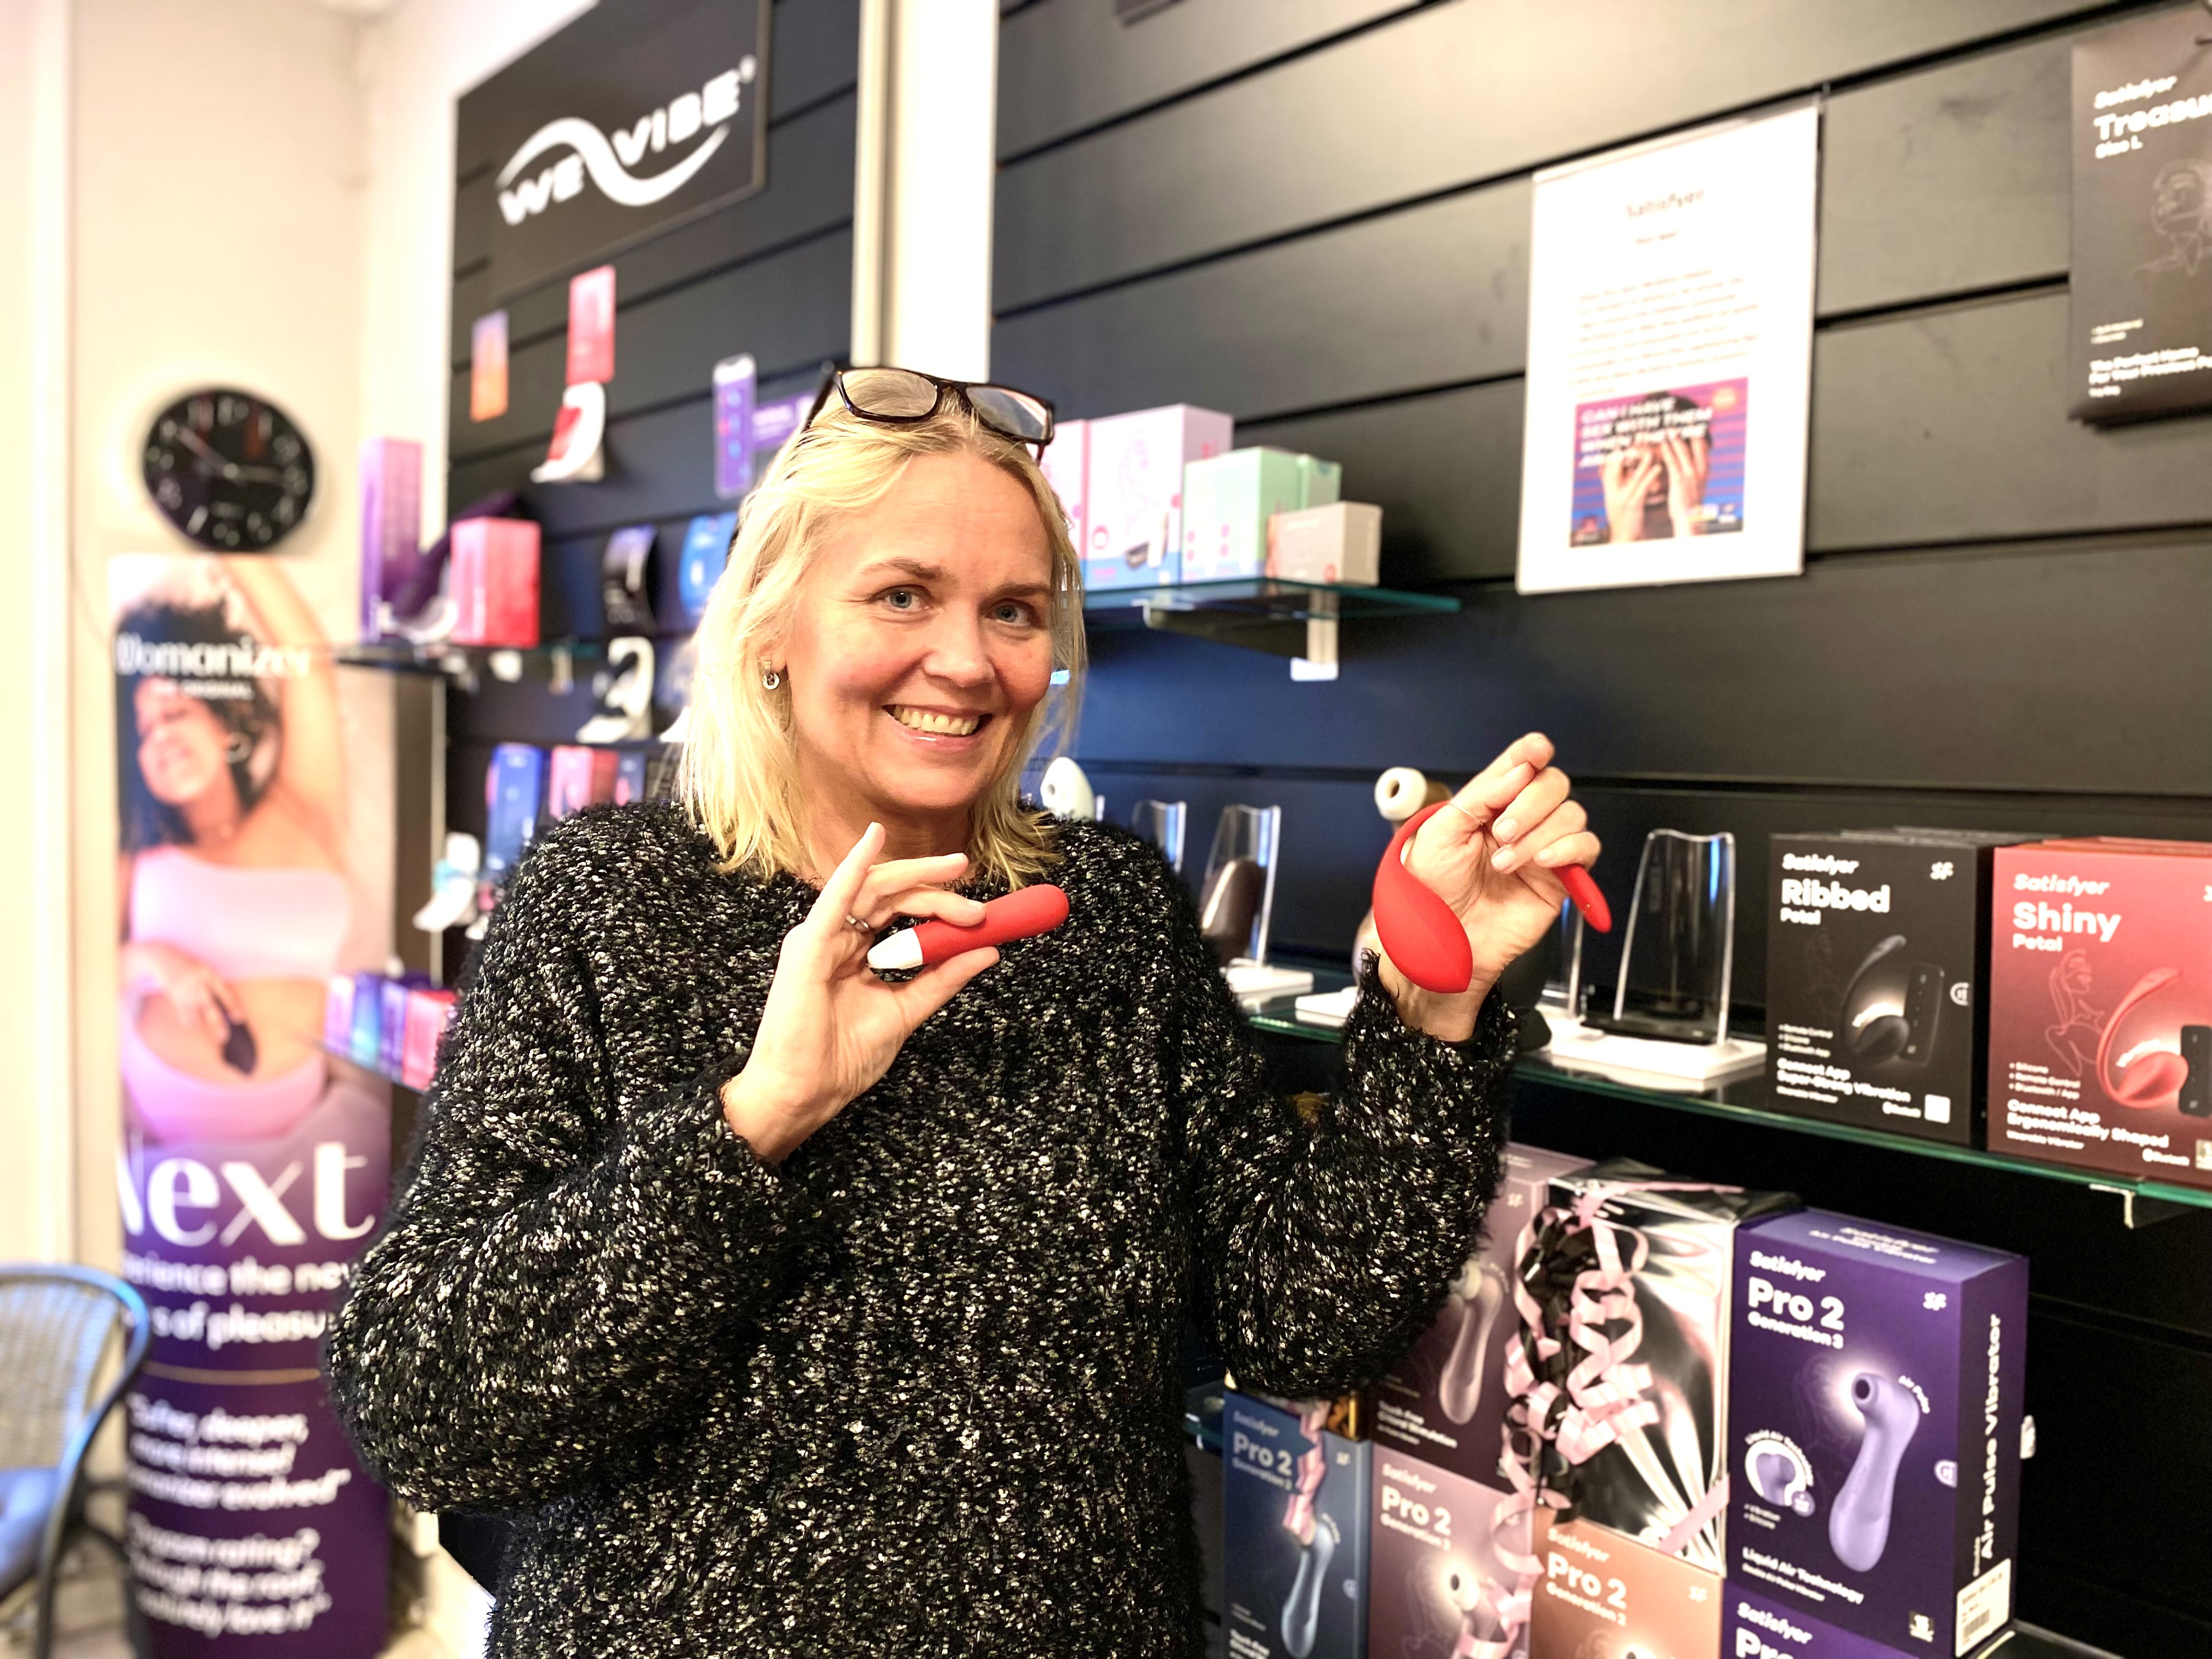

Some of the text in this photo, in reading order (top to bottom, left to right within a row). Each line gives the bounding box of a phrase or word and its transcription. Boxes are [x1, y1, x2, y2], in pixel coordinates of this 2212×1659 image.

[1781, 878, 1891, 913] Ribbed
[2013, 873, 2110, 896] Satisfyer
[1780, 907, 1821, 926] Petal
[2012, 900, 2121, 943] Shiny
[2012, 933, 2063, 952] Petal
[1825, 1065, 1852, 1081] App
[2007, 1098, 2101, 1125] Connect App
[2111, 1127, 2169, 1148] Shaped
[1750, 1250, 1826, 1283] Satisfyer
[1748, 1276, 1844, 1331] Pro 2
[207, 1302, 329, 1351] pleasu
[1747, 1310, 1832, 1347] Generation
[1233, 1431, 1293, 1477] Pro 2
[1980, 1313, 2001, 1559] Air Pulse Vibrator
[1381, 1484, 1452, 1536] Pro 2
[1547, 1527, 1611, 1563] Satisfyer
[1547, 1550, 1627, 1610] Pro 2
[1545, 1581, 1617, 1623] Generation
[1737, 1602, 1813, 1644] Satisfyer
[1736, 1627, 1795, 1659] Pr
